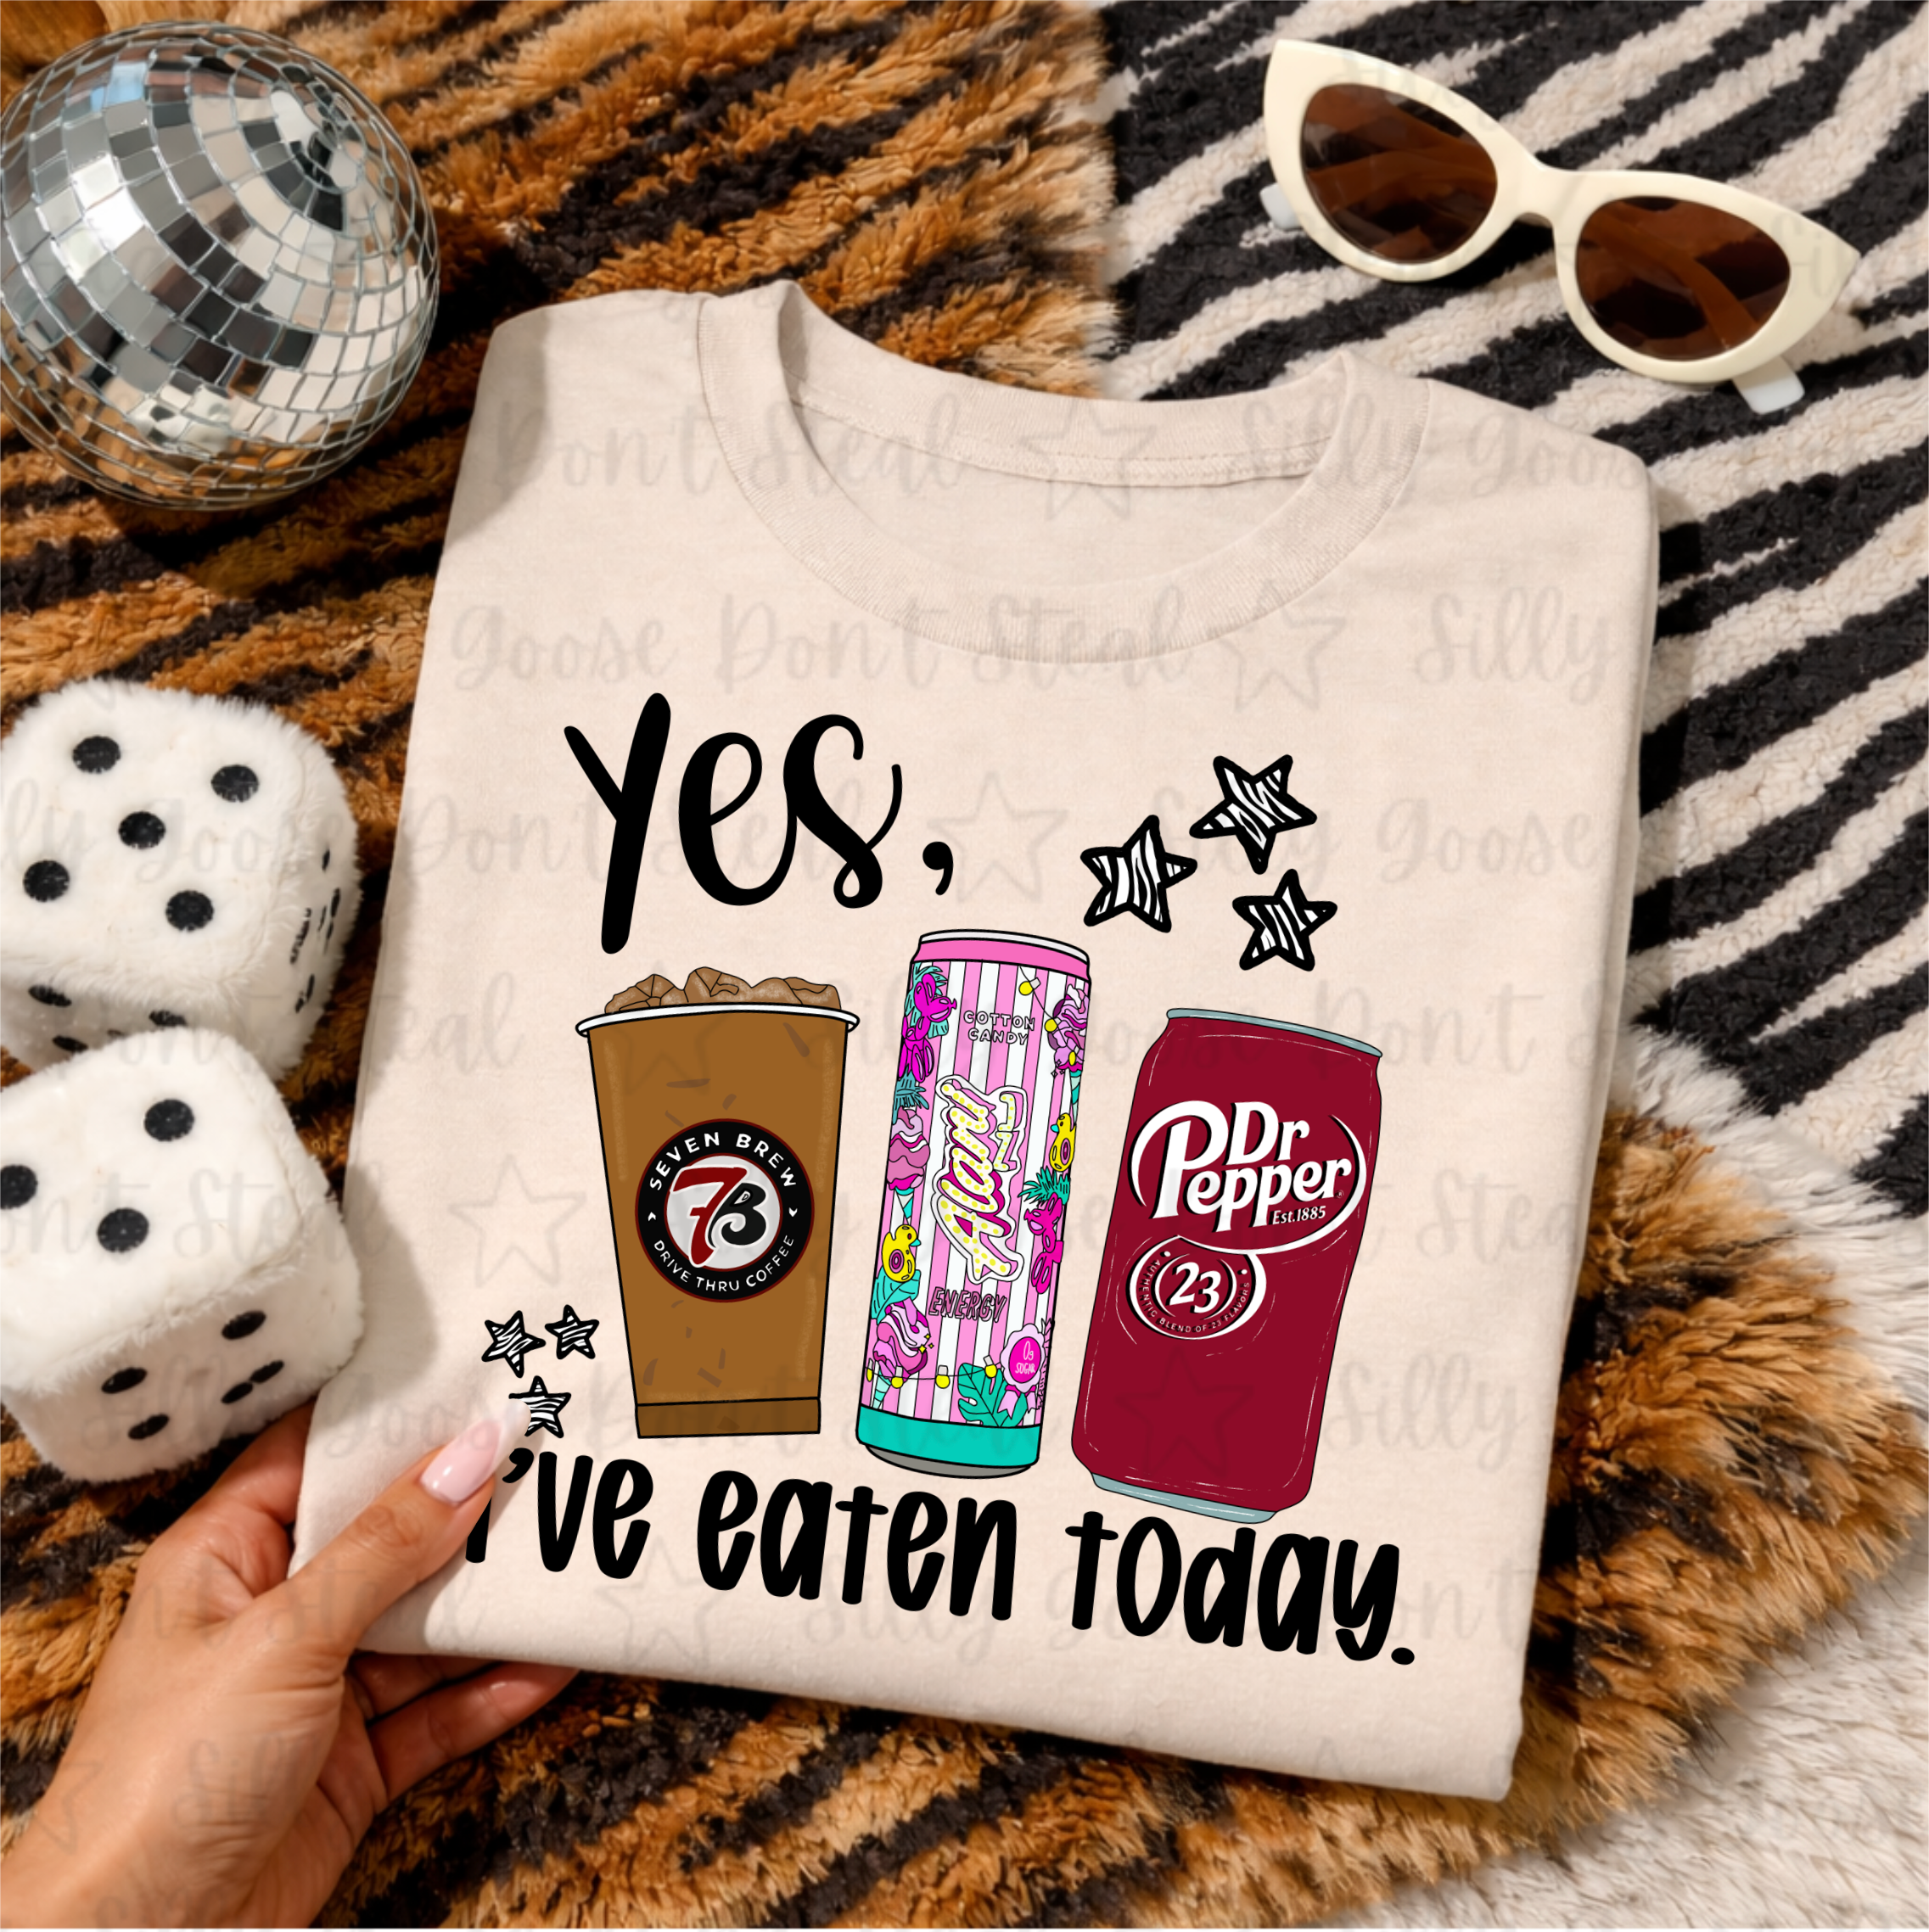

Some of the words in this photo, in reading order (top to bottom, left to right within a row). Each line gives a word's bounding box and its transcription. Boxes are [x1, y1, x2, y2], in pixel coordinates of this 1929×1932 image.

[564, 692, 954, 954] Yes,
[963, 1011, 1035, 1031] COTTON
[967, 1028, 1029, 1045] CANDY
[649, 1131, 721, 1190] SEVEN
[735, 1133, 797, 1188] BREW
[1130, 1099, 1353, 1233] Pepper
[1226, 1101, 1310, 1166] Dr
[935, 1082, 1013, 1280] Alani
[670, 1164, 770, 1268] 7B
[653, 1240, 692, 1283] DRIVE
[696, 1276, 740, 1292] THRU
[745, 1235, 794, 1287] COFFEE
[1142, 1259, 1161, 1318] AUTHENTIC
[1159, 1317, 1192, 1333] BLEND
[1195, 1324, 1208, 1333] OF
[1211, 1321, 1222, 1330] 23
[1224, 1282, 1250, 1322] FLAVORS
[1168, 1261, 1222, 1313] 23
[928, 1286, 1008, 1323] ENERGY
[697, 1470, 1018, 1621] eaten
[1064, 1510, 1416, 1666] today.
